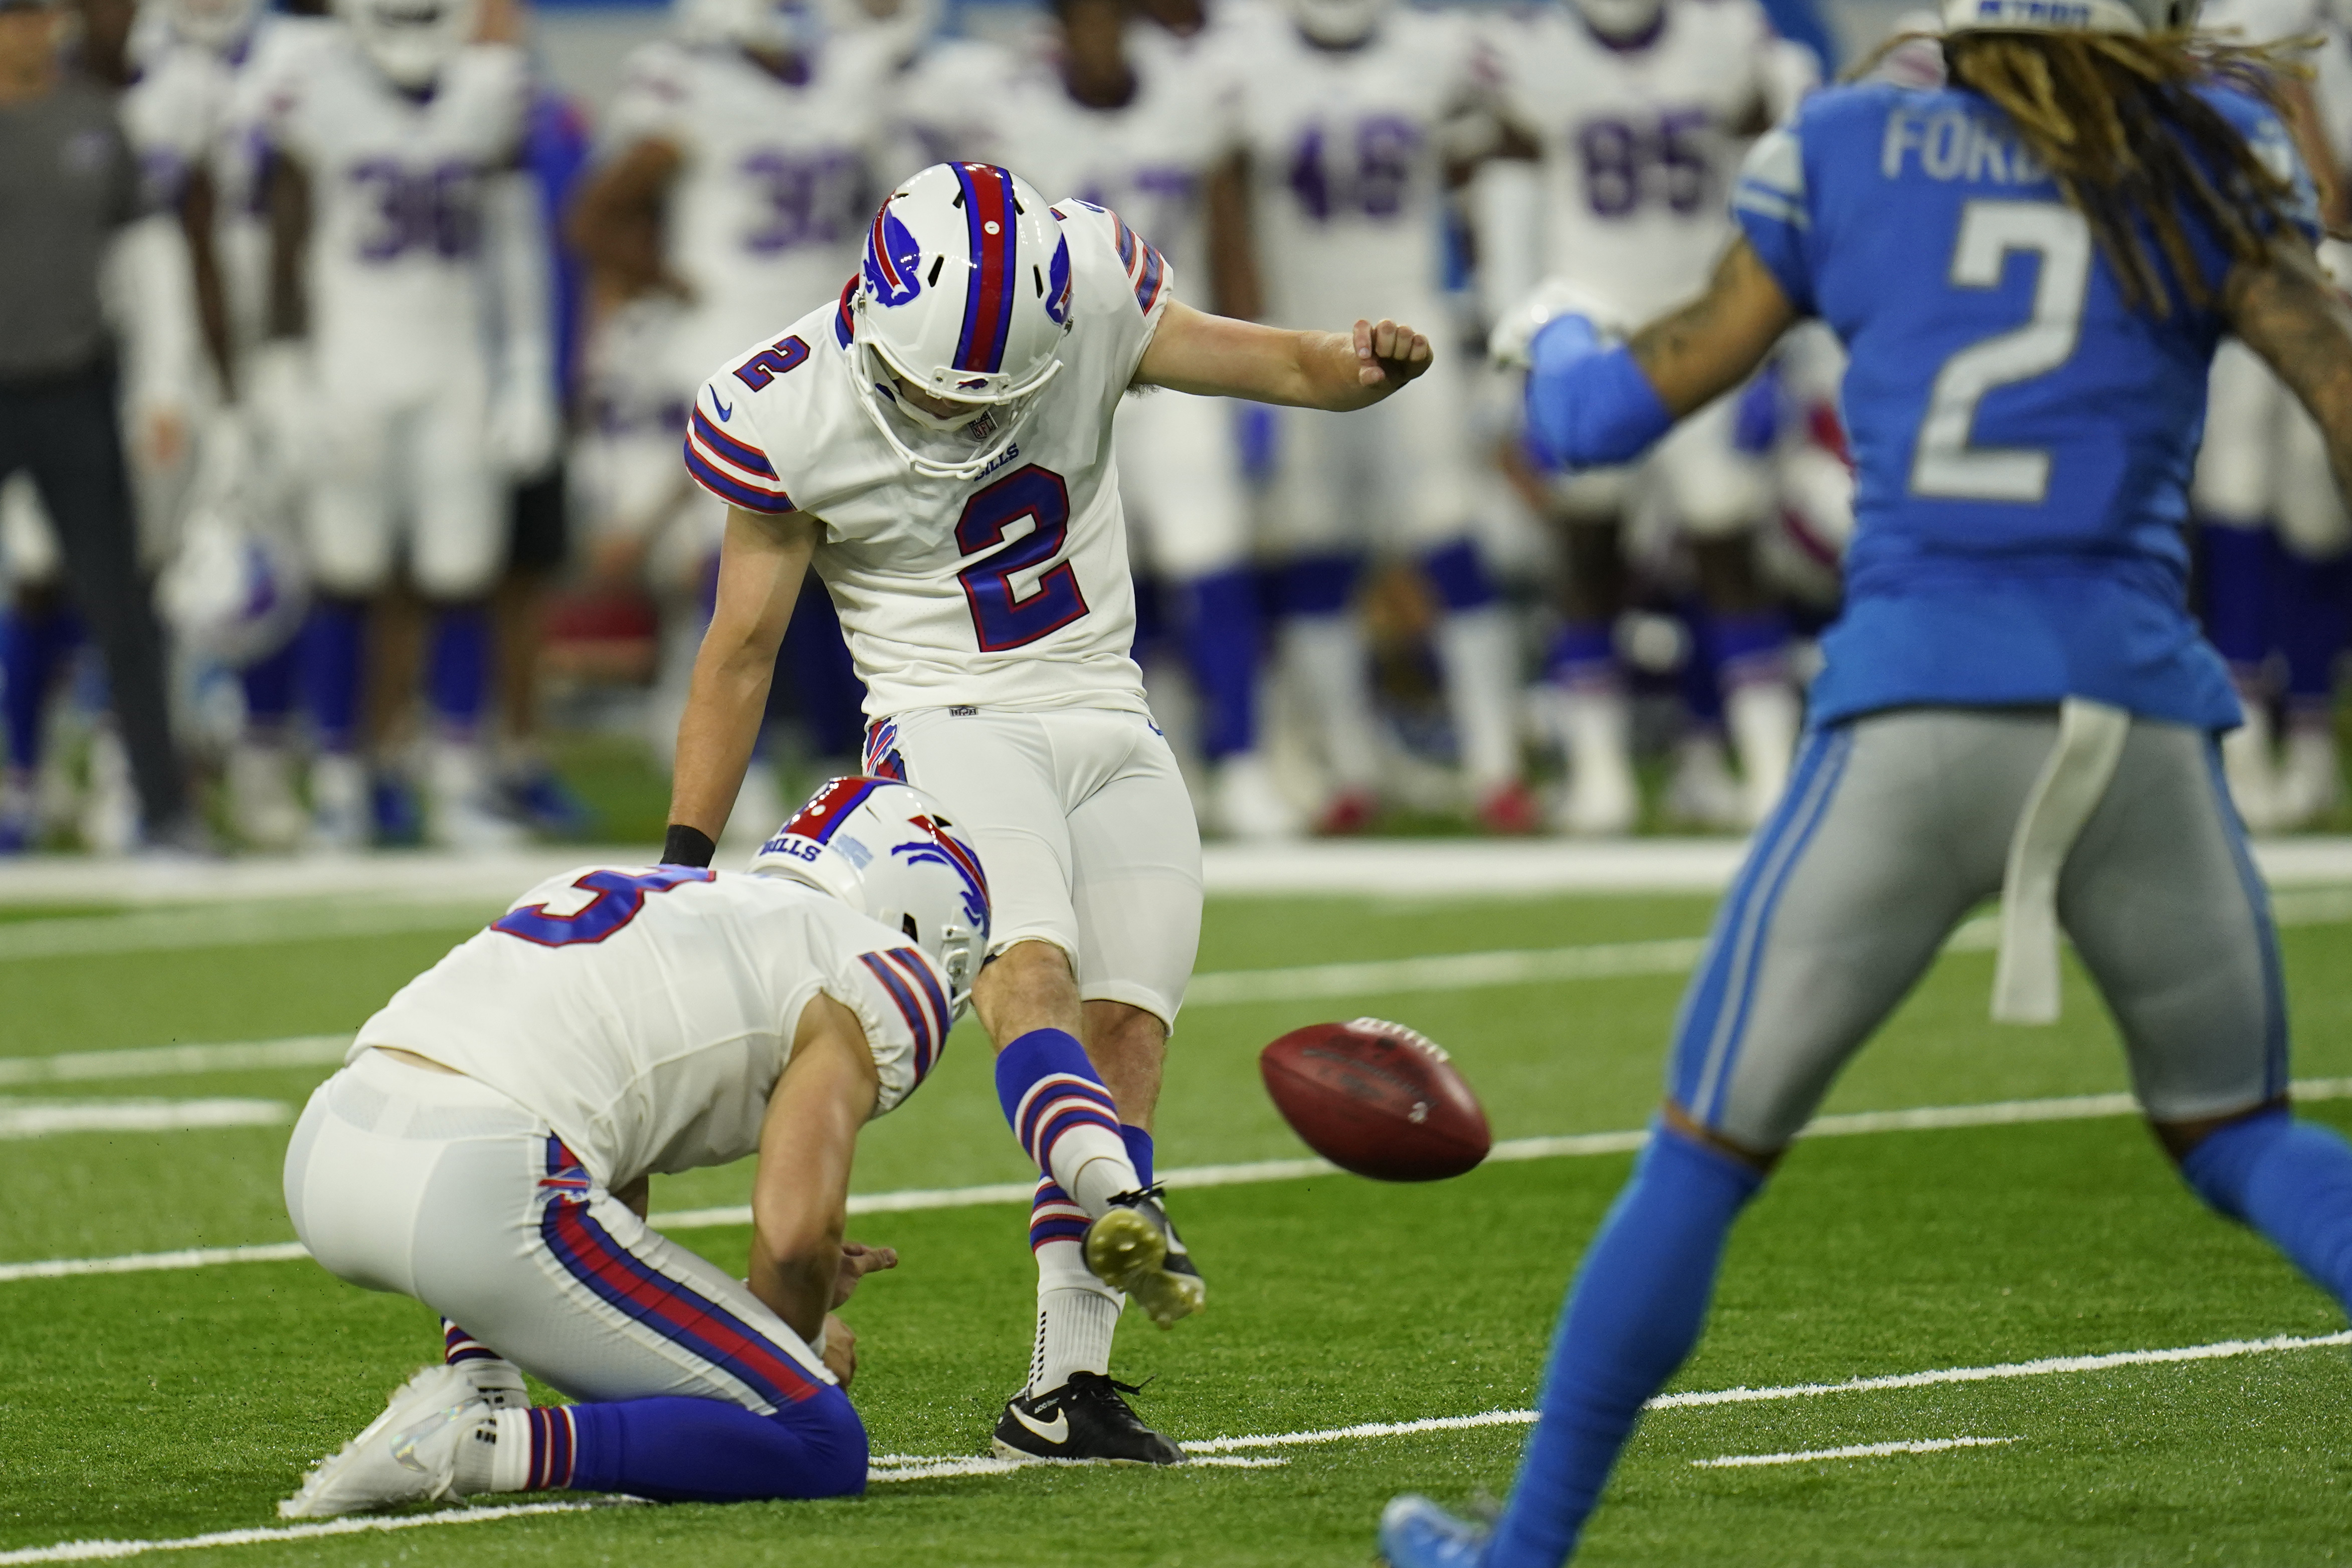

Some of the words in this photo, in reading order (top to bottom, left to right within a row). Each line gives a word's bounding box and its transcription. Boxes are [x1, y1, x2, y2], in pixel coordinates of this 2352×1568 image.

[1579, 109, 1712, 217] 85
[732, 334, 811, 393] 2
[1911, 199, 2091, 501] 2
[954, 463, 1090, 653] 2
[490, 864, 716, 948] 3
